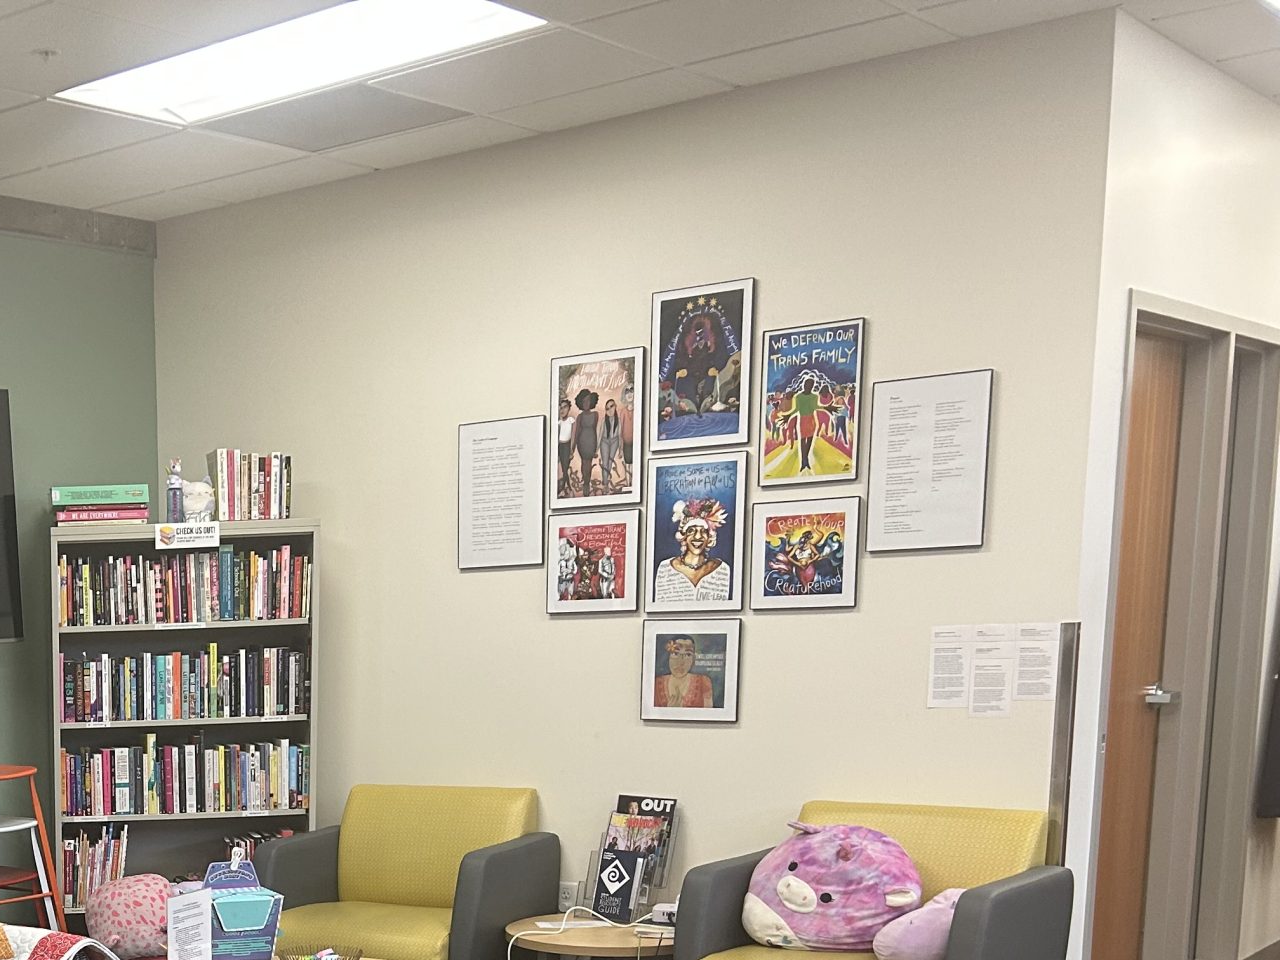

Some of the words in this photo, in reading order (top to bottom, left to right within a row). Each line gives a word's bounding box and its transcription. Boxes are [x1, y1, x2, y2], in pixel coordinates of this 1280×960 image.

[770, 352, 808, 371] TRANS
[812, 346, 856, 364] FAMILY
[176, 527, 194, 535] CHECK
[641, 799, 675, 813] OUT
[598, 906, 620, 915] GUIDE
